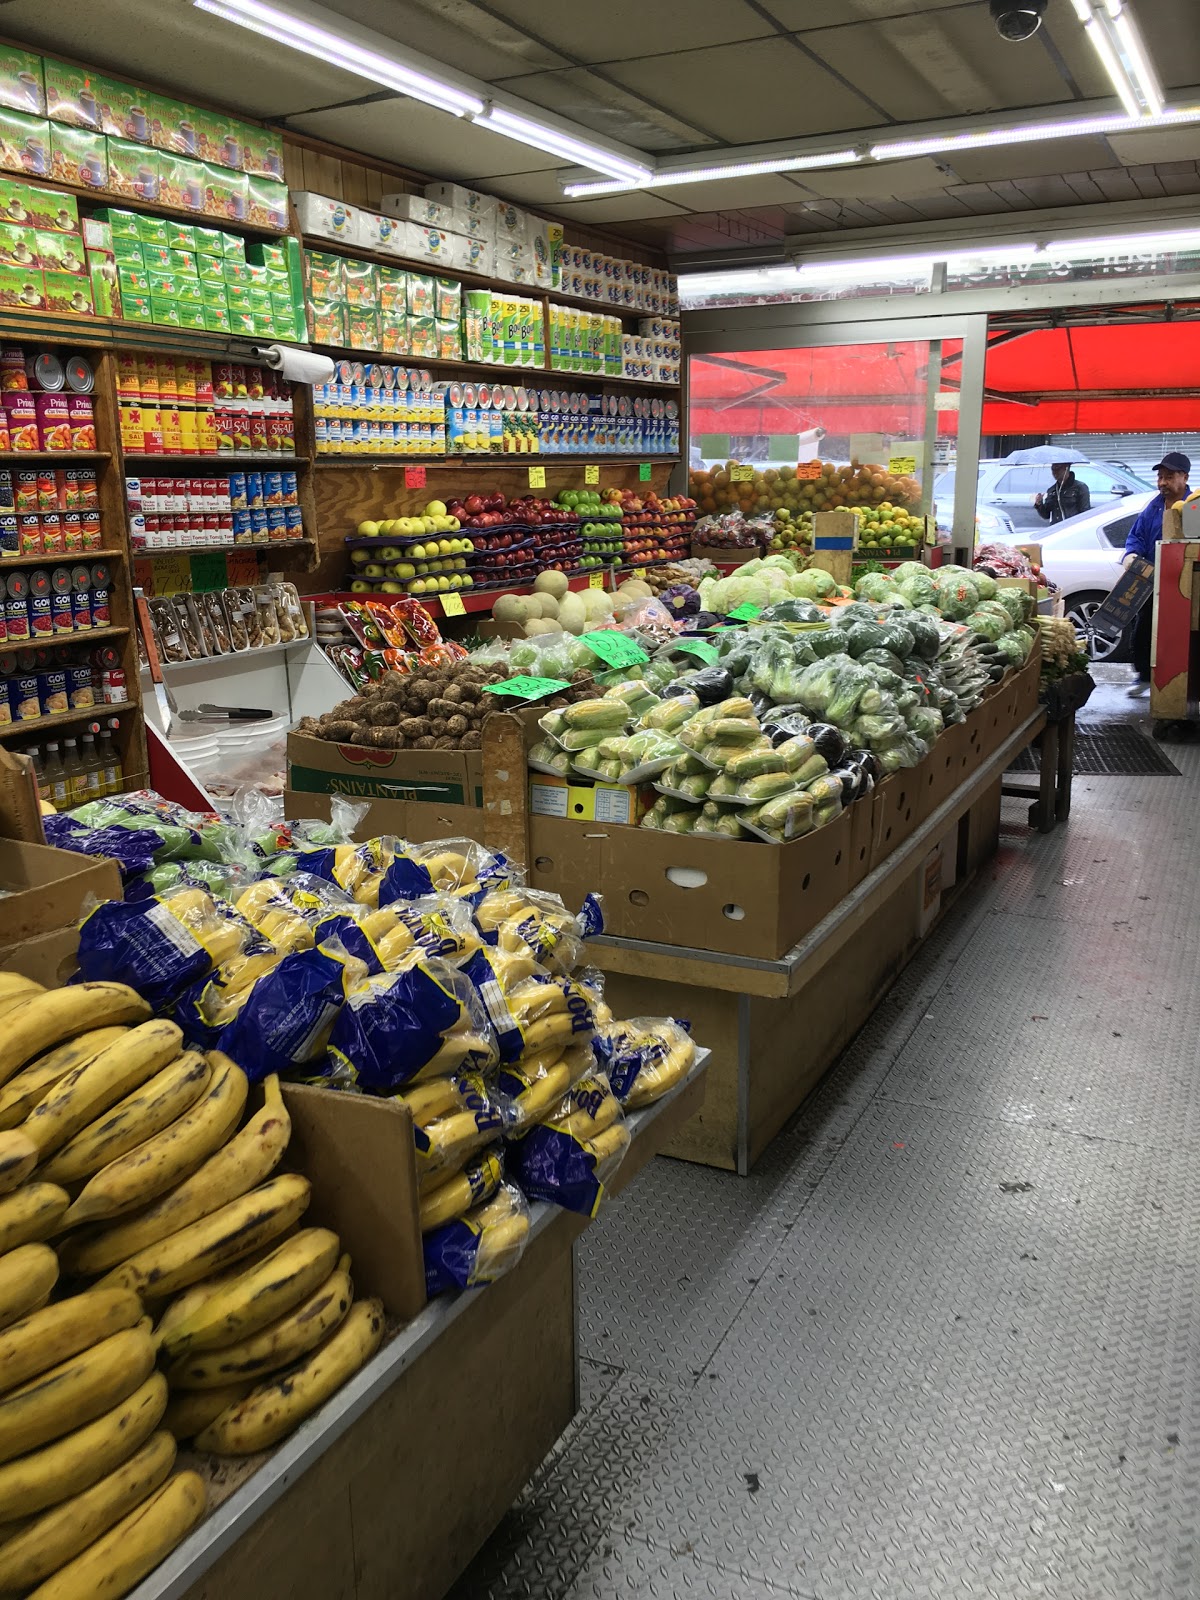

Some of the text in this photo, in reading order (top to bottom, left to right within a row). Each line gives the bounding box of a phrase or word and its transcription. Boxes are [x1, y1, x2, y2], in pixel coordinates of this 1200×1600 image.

[46, 70, 80, 91] Ginger
[99, 87, 131, 107] Ginger
[150, 103, 179, 121] Ginger
[856, 549, 902, 557] PLNTAINS
[329, 777, 419, 802] PLANTAINS
